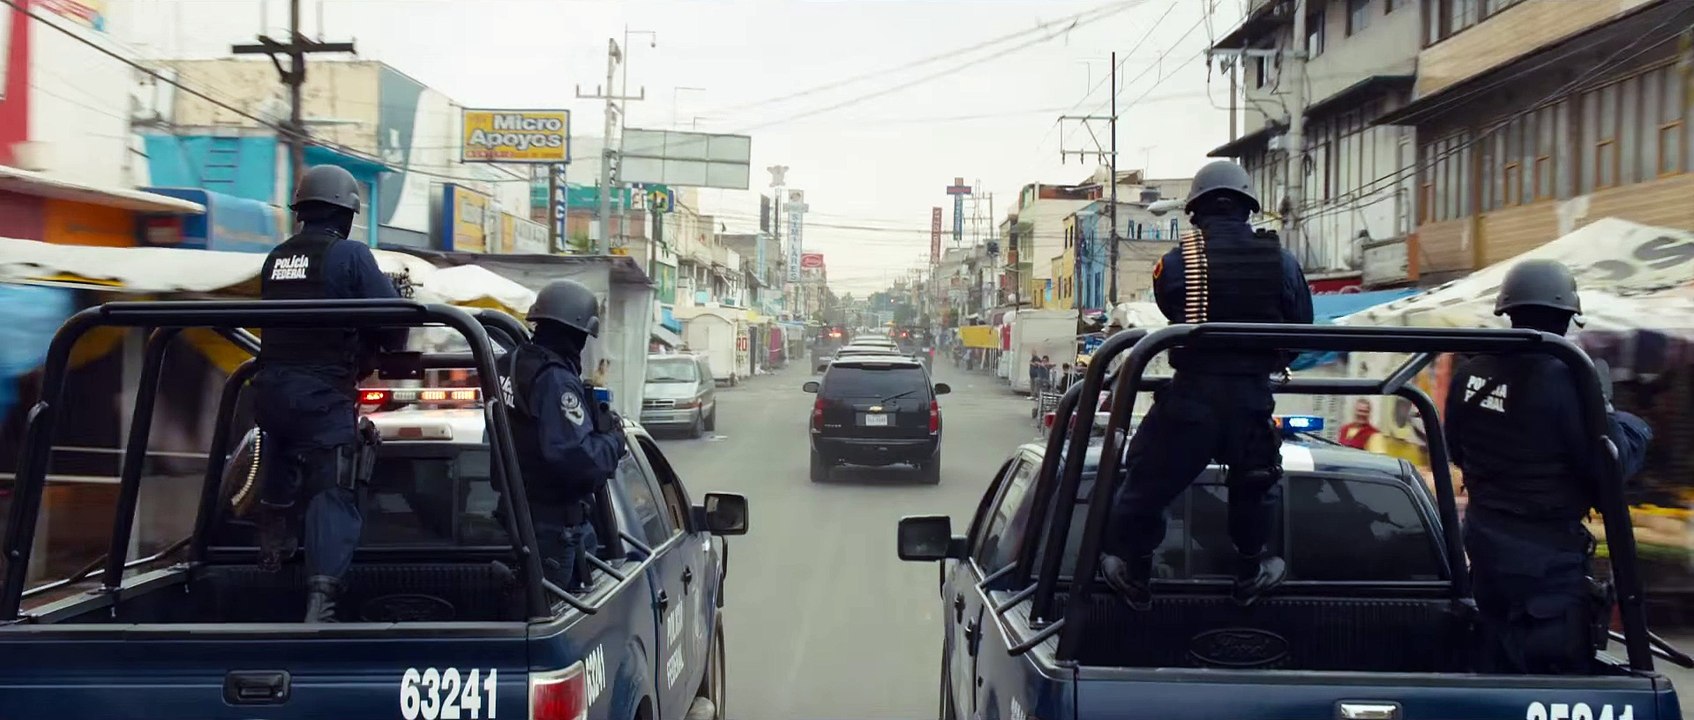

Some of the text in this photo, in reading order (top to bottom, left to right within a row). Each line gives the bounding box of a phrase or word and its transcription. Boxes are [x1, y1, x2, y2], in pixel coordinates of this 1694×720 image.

[494, 113, 562, 131] Micro
[469, 129, 563, 150] Apoyos
[271, 268, 307, 280] FEDERAL
[400, 667, 498, 720] 63241
